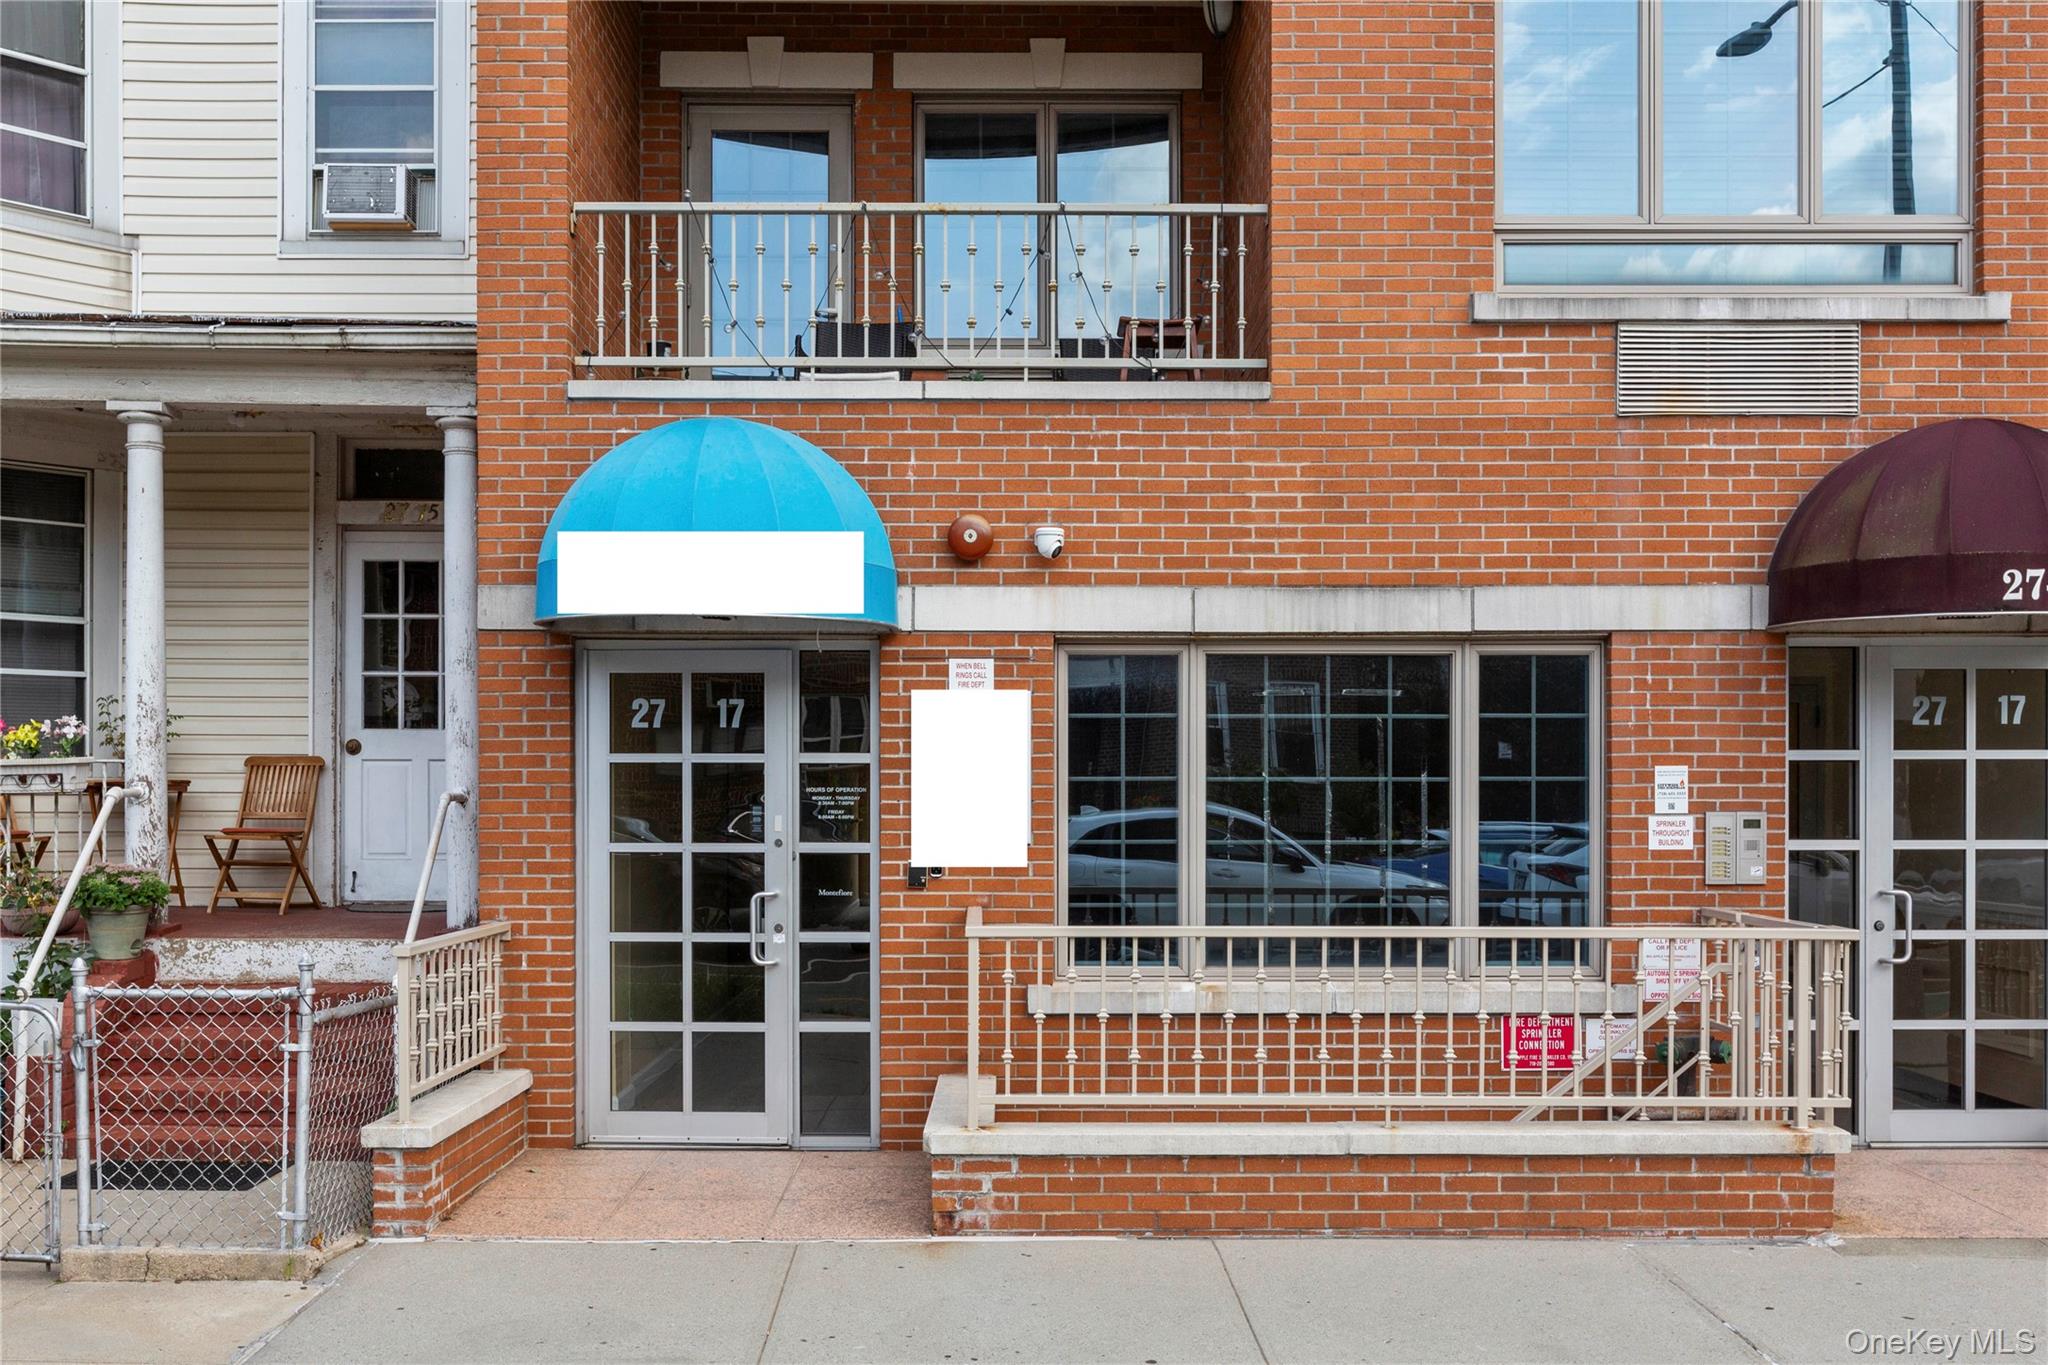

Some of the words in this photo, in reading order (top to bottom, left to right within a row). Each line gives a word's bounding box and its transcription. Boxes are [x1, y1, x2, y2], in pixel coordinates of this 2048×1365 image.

[2002, 568, 2048, 601] 27
[956, 671, 972, 679] RINGS
[973, 671, 987, 679] CALL
[631, 697, 666, 729] 27
[717, 698, 745, 729] 17
[1912, 695, 1947, 726] 27
[1998, 695, 2026, 725] 17
[1655, 820, 1687, 828] SPRINKLER
[1652, 829, 1690, 837] THROUGHOUT
[1658, 839, 1684, 847] BUILDING
[818, 888, 854, 897] Montefiore
[1521, 1028, 1562, 1039] SPRINLER
[1518, 1040, 1566, 1050] CONNETION
